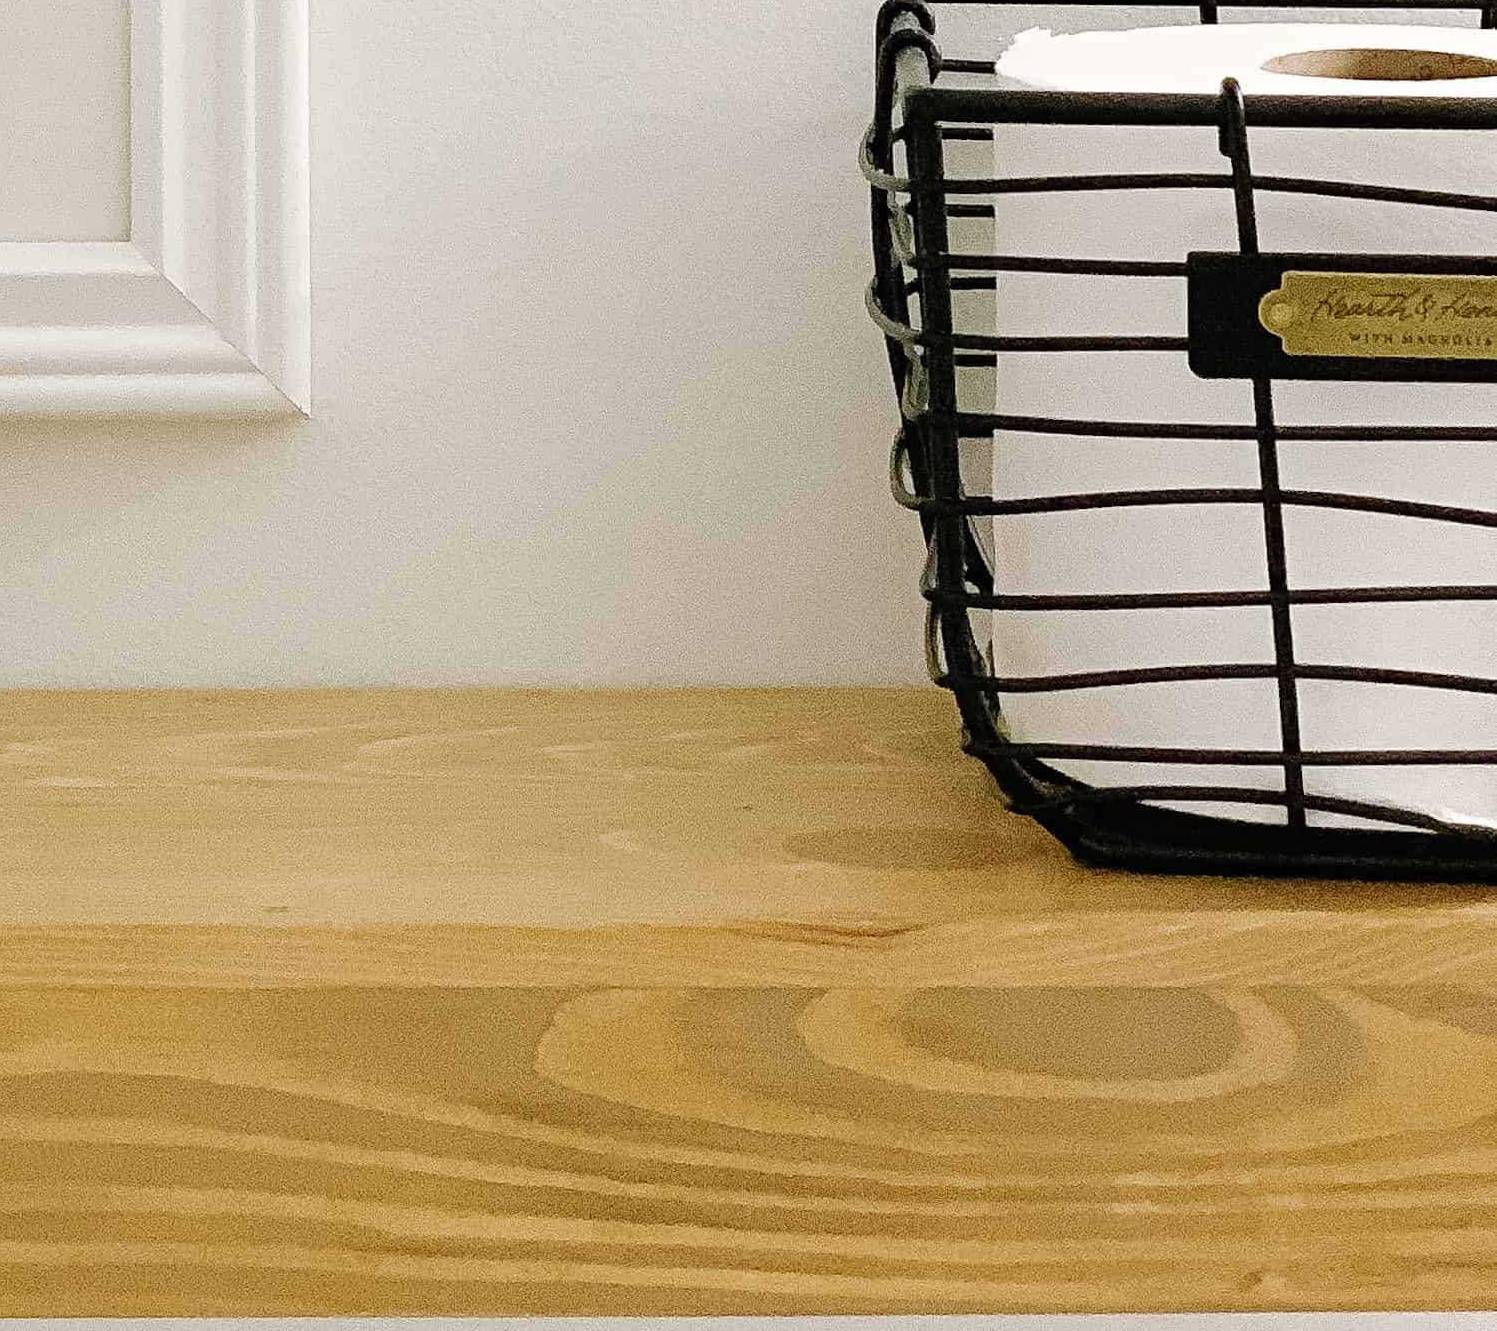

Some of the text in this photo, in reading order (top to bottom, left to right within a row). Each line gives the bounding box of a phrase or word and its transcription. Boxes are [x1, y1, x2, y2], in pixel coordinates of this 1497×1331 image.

[1311, 287, 1497, 322] Hearth & Han
[1349, 332, 1493, 347] WITH MAGNOLIA
